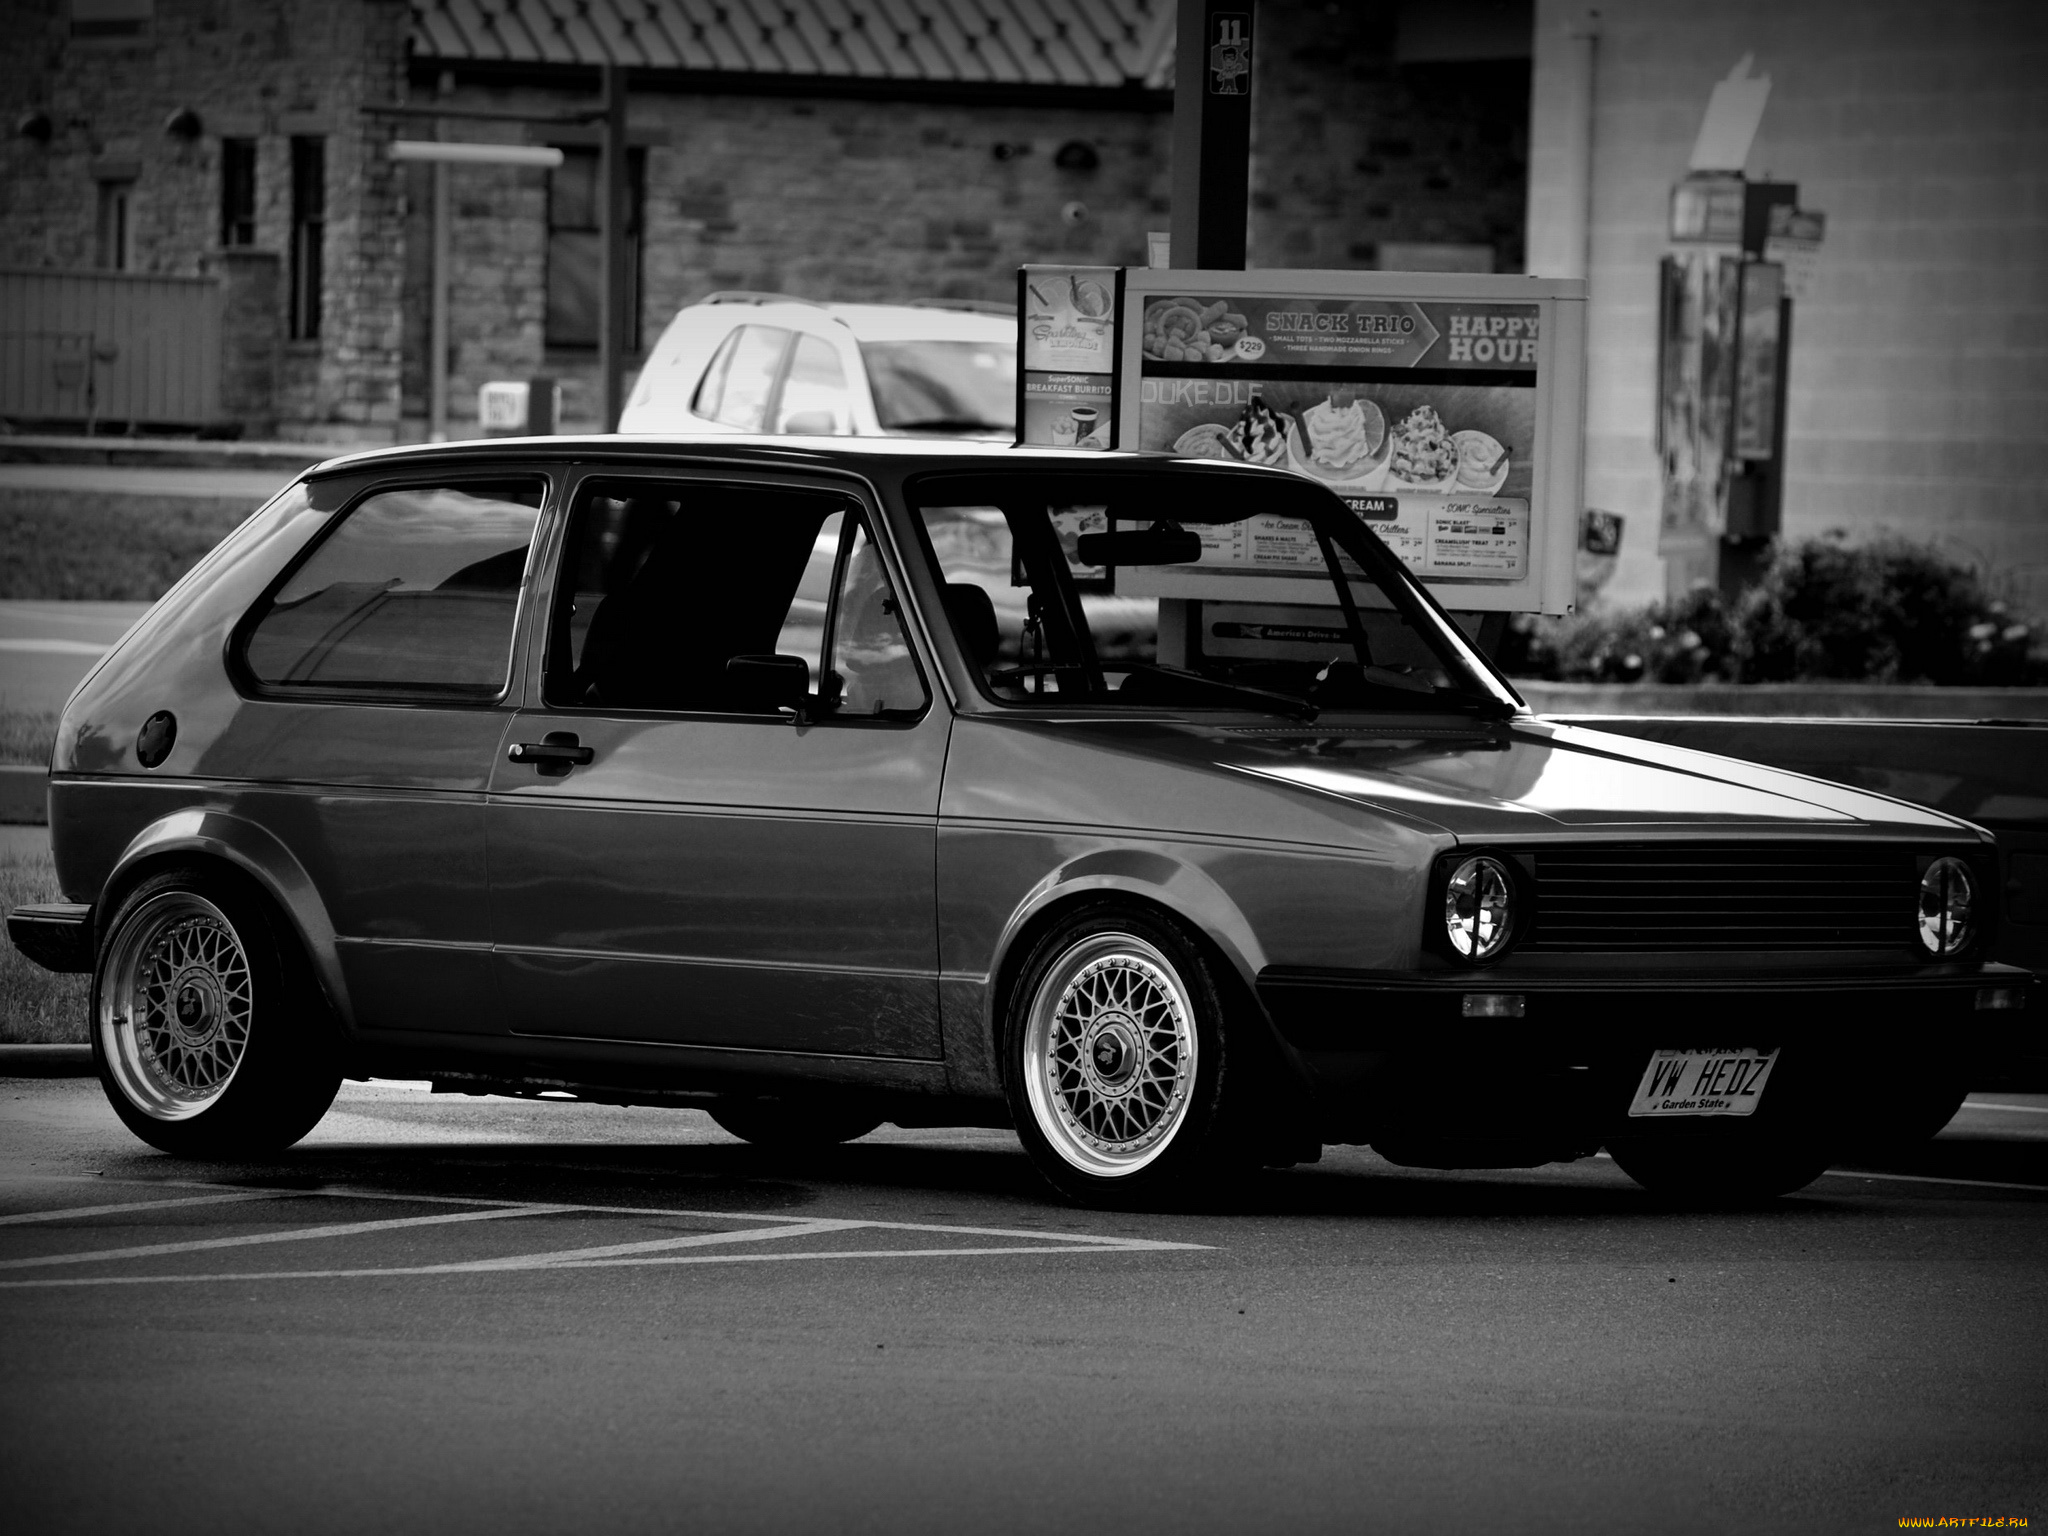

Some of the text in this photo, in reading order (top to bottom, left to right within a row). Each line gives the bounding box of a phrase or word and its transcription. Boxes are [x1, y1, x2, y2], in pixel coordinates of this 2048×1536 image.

[1220, 20, 1241, 45] 11
[1266, 311, 1415, 334] SNACK TRIO
[1449, 316, 1539, 337] HAPPY
[1309, 345, 1347, 353] HANDMADE
[1336, 337, 1380, 345] MOZZARELLA
[1448, 337, 1538, 363] HOUR
[1026, 383, 1112, 395] BREAKFAST BURRITO
[1648, 1058, 1769, 1097] VW HEDZ
[1661, 1098, 1725, 1110] Garden State
